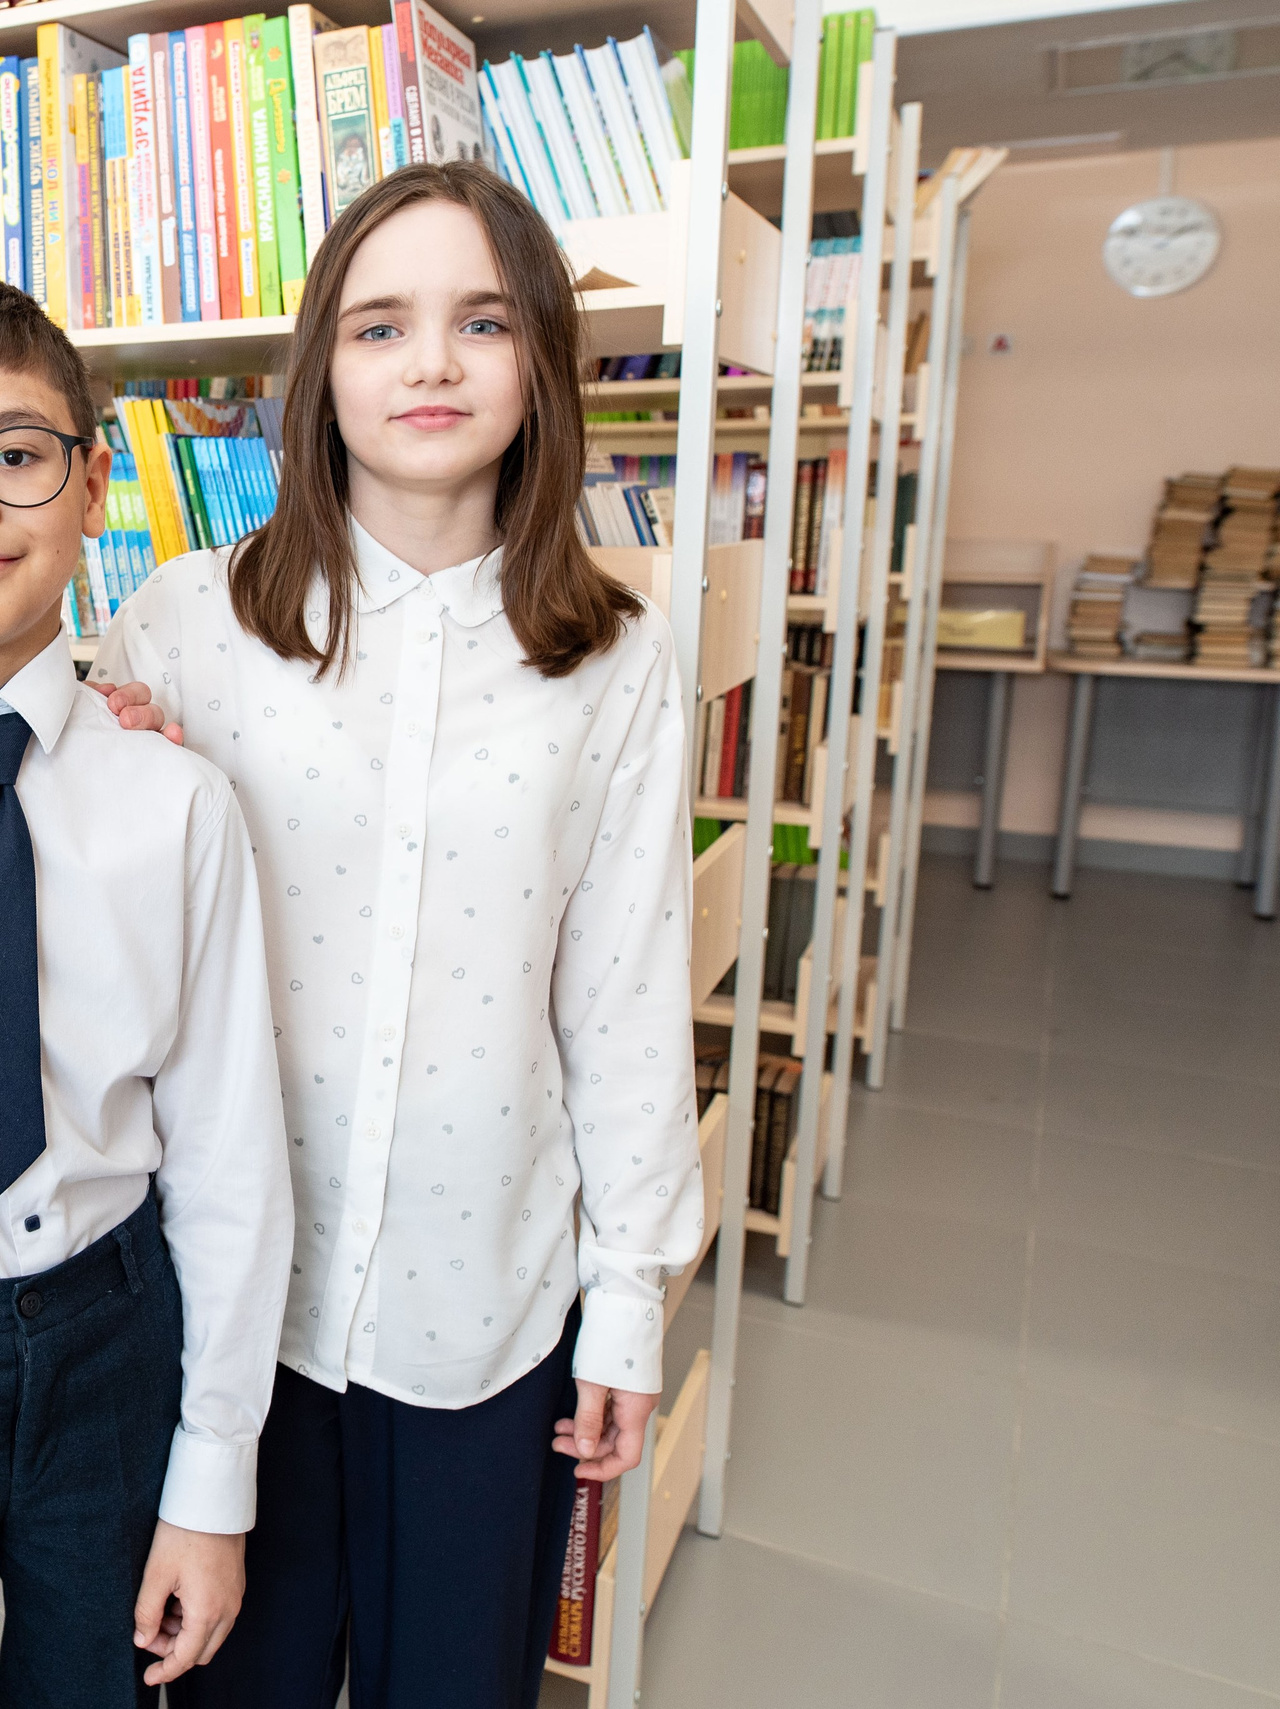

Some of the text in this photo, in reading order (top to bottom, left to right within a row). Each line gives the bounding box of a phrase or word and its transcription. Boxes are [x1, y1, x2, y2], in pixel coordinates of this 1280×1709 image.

[131, 65, 151, 147] ЭРУДИТА
[252, 107, 268, 163] КНИГА
[326, 85, 368, 115] БРЕМ
[404, 85, 424, 163] СДЕЛАНО В РОСС
[25, 65, 45, 301] ЭНЦИКЛОПЕДИЯ ЧУДЕС ПРИРОДЫ
[86, 80, 104, 325] ПРАВИЛА ПОВЕДЕНИЯ ДЛЯ ВОСПИТАННЫХ ДЕТЕЙ
[255, 166, 273, 241] КРАСНАЯ
[568, 1487, 589, 1657] СЛОВАРЬ РУССКОГО ЯЗЫКА
